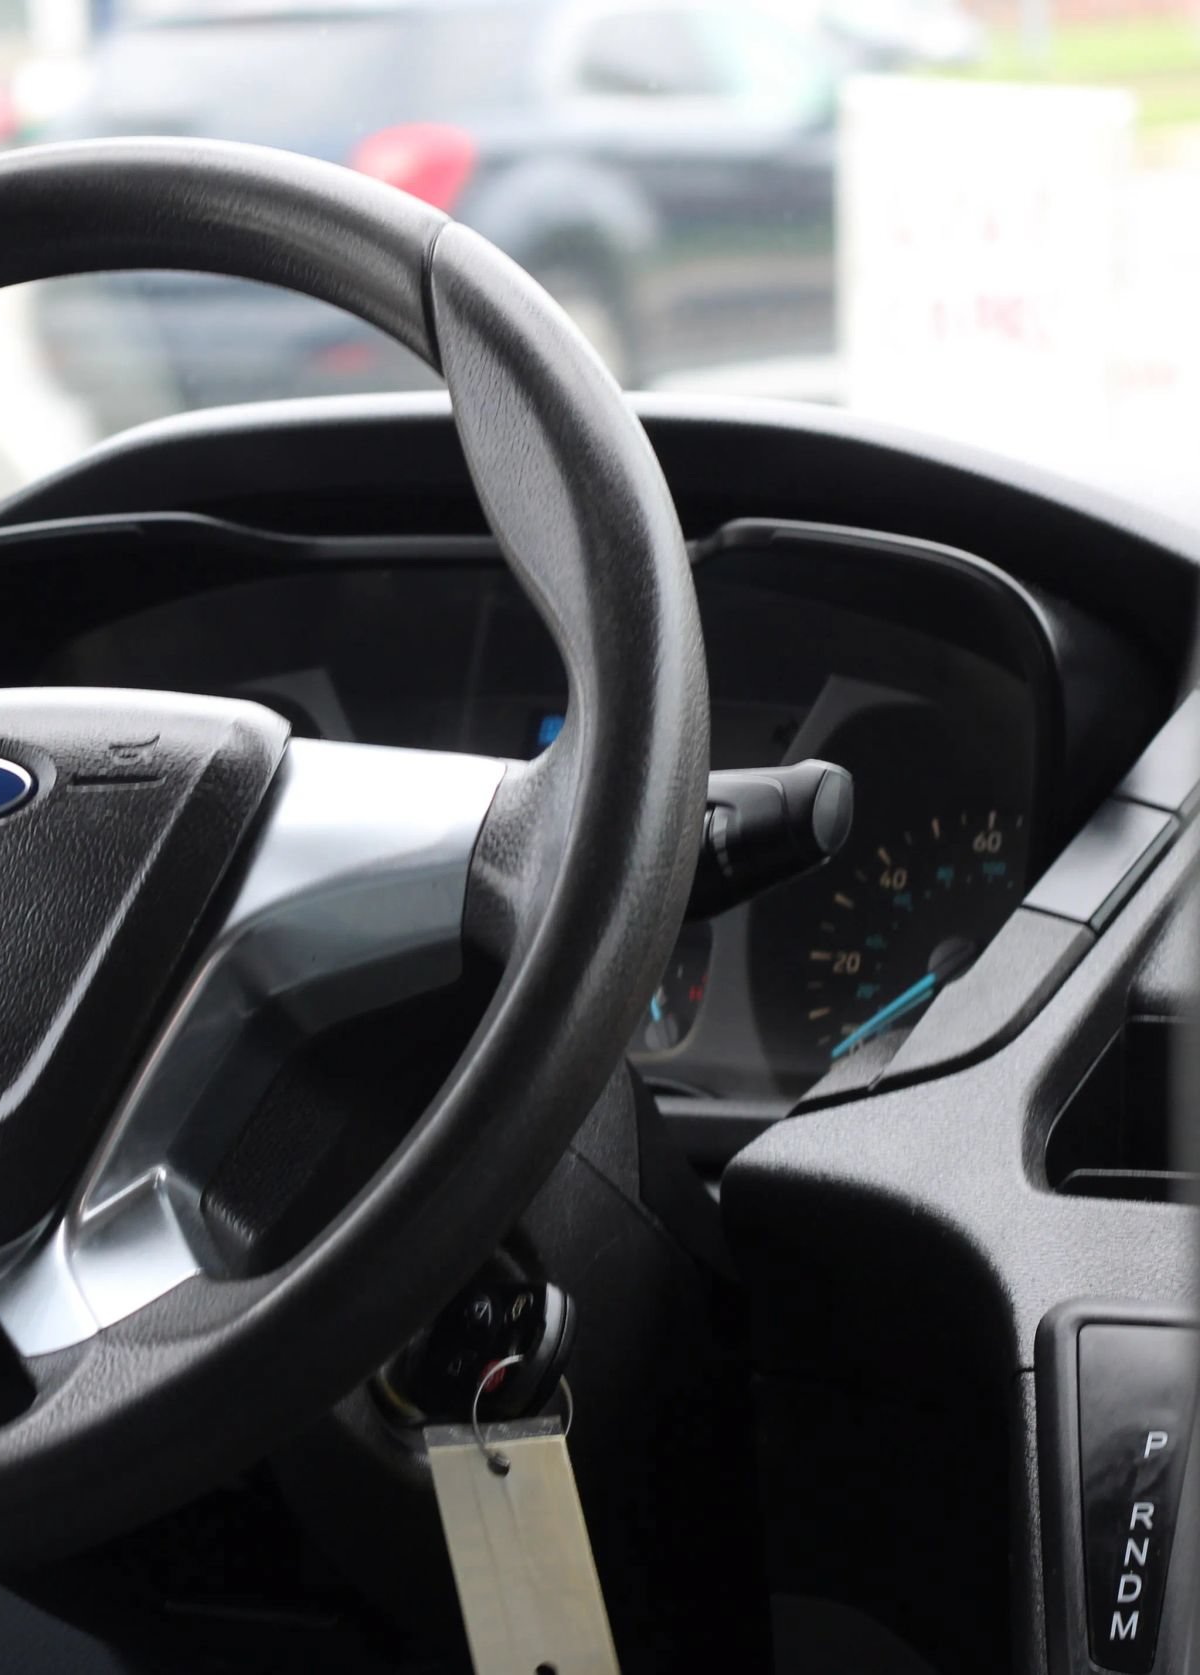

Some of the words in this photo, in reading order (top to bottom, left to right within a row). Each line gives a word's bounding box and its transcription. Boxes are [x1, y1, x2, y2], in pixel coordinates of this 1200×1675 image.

[973, 831, 1003, 853] 60
[880, 868, 909, 890] 40
[833, 950, 861, 974] 20
[1144, 1431, 1169, 1459] P
[1130, 1502, 1155, 1530] R
[1124, 1537, 1150, 1567] N
[1117, 1573, 1142, 1604] D
[1109, 1610, 1140, 1641] M
